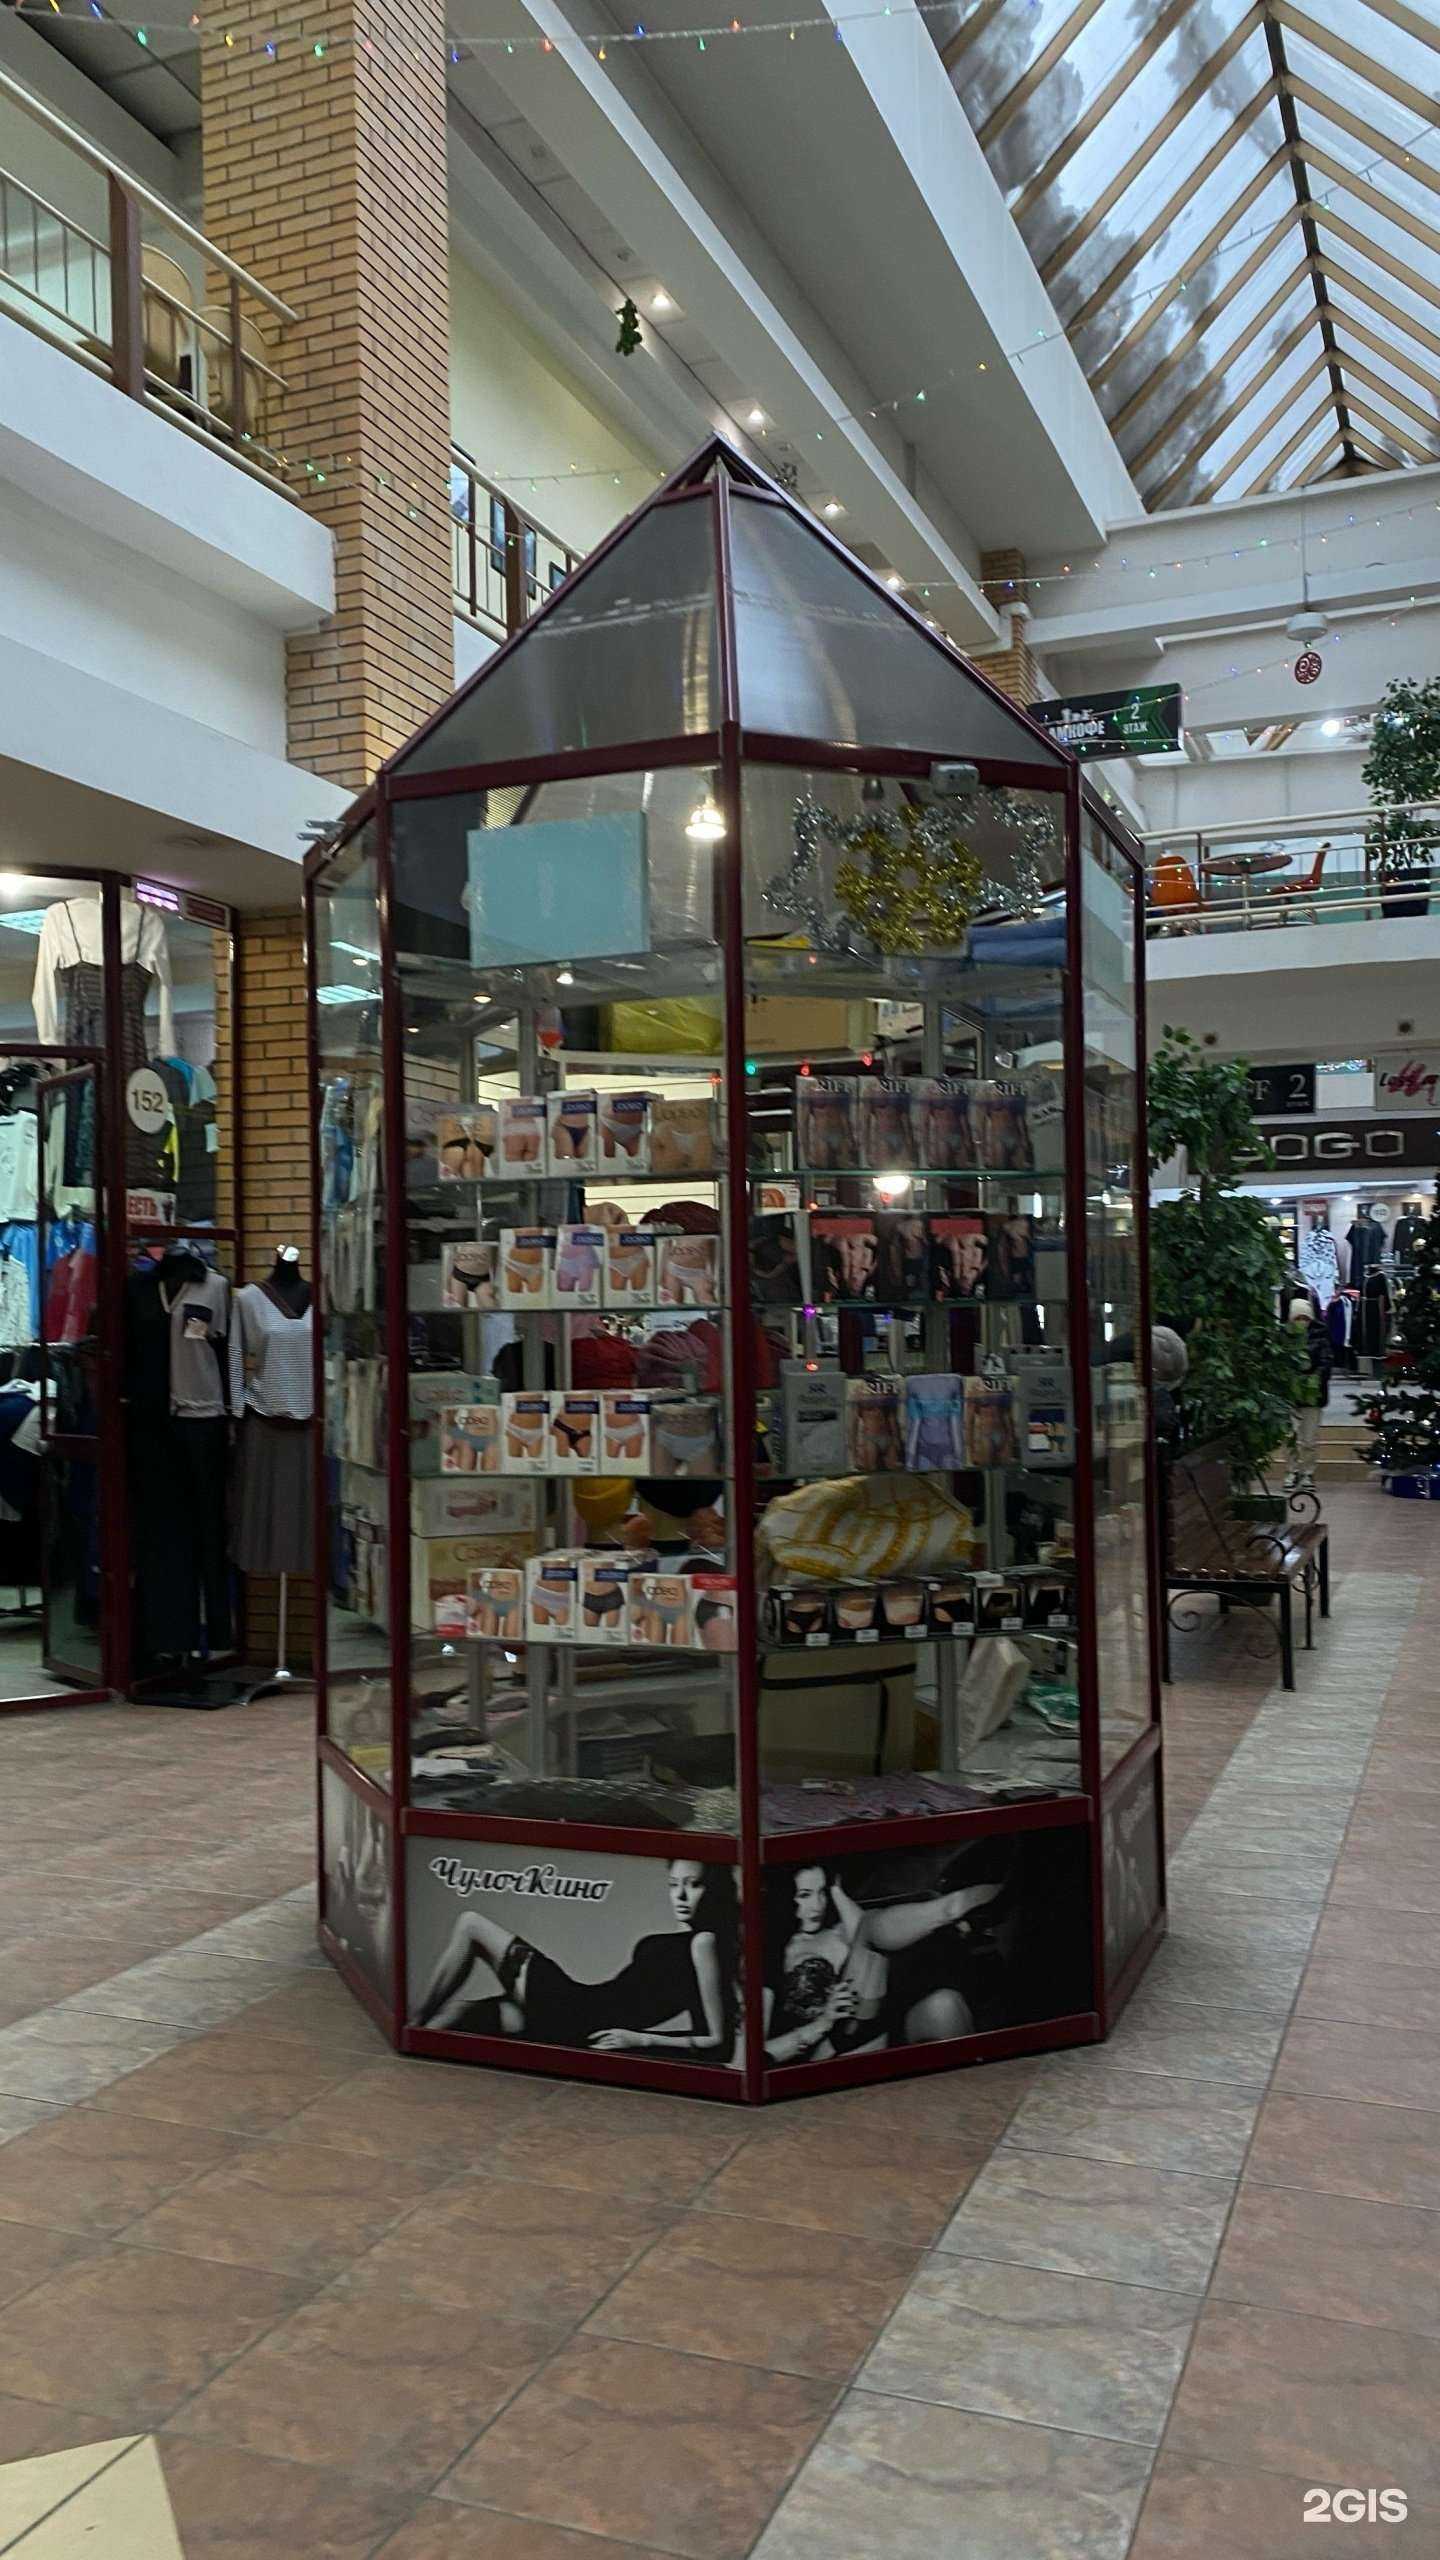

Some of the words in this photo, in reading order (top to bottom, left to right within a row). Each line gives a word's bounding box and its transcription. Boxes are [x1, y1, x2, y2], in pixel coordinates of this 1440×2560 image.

[1130, 703, 1141, 719] 2
[1288, 1073, 1308, 1098] 2
[131, 1089, 164, 1113] 152
